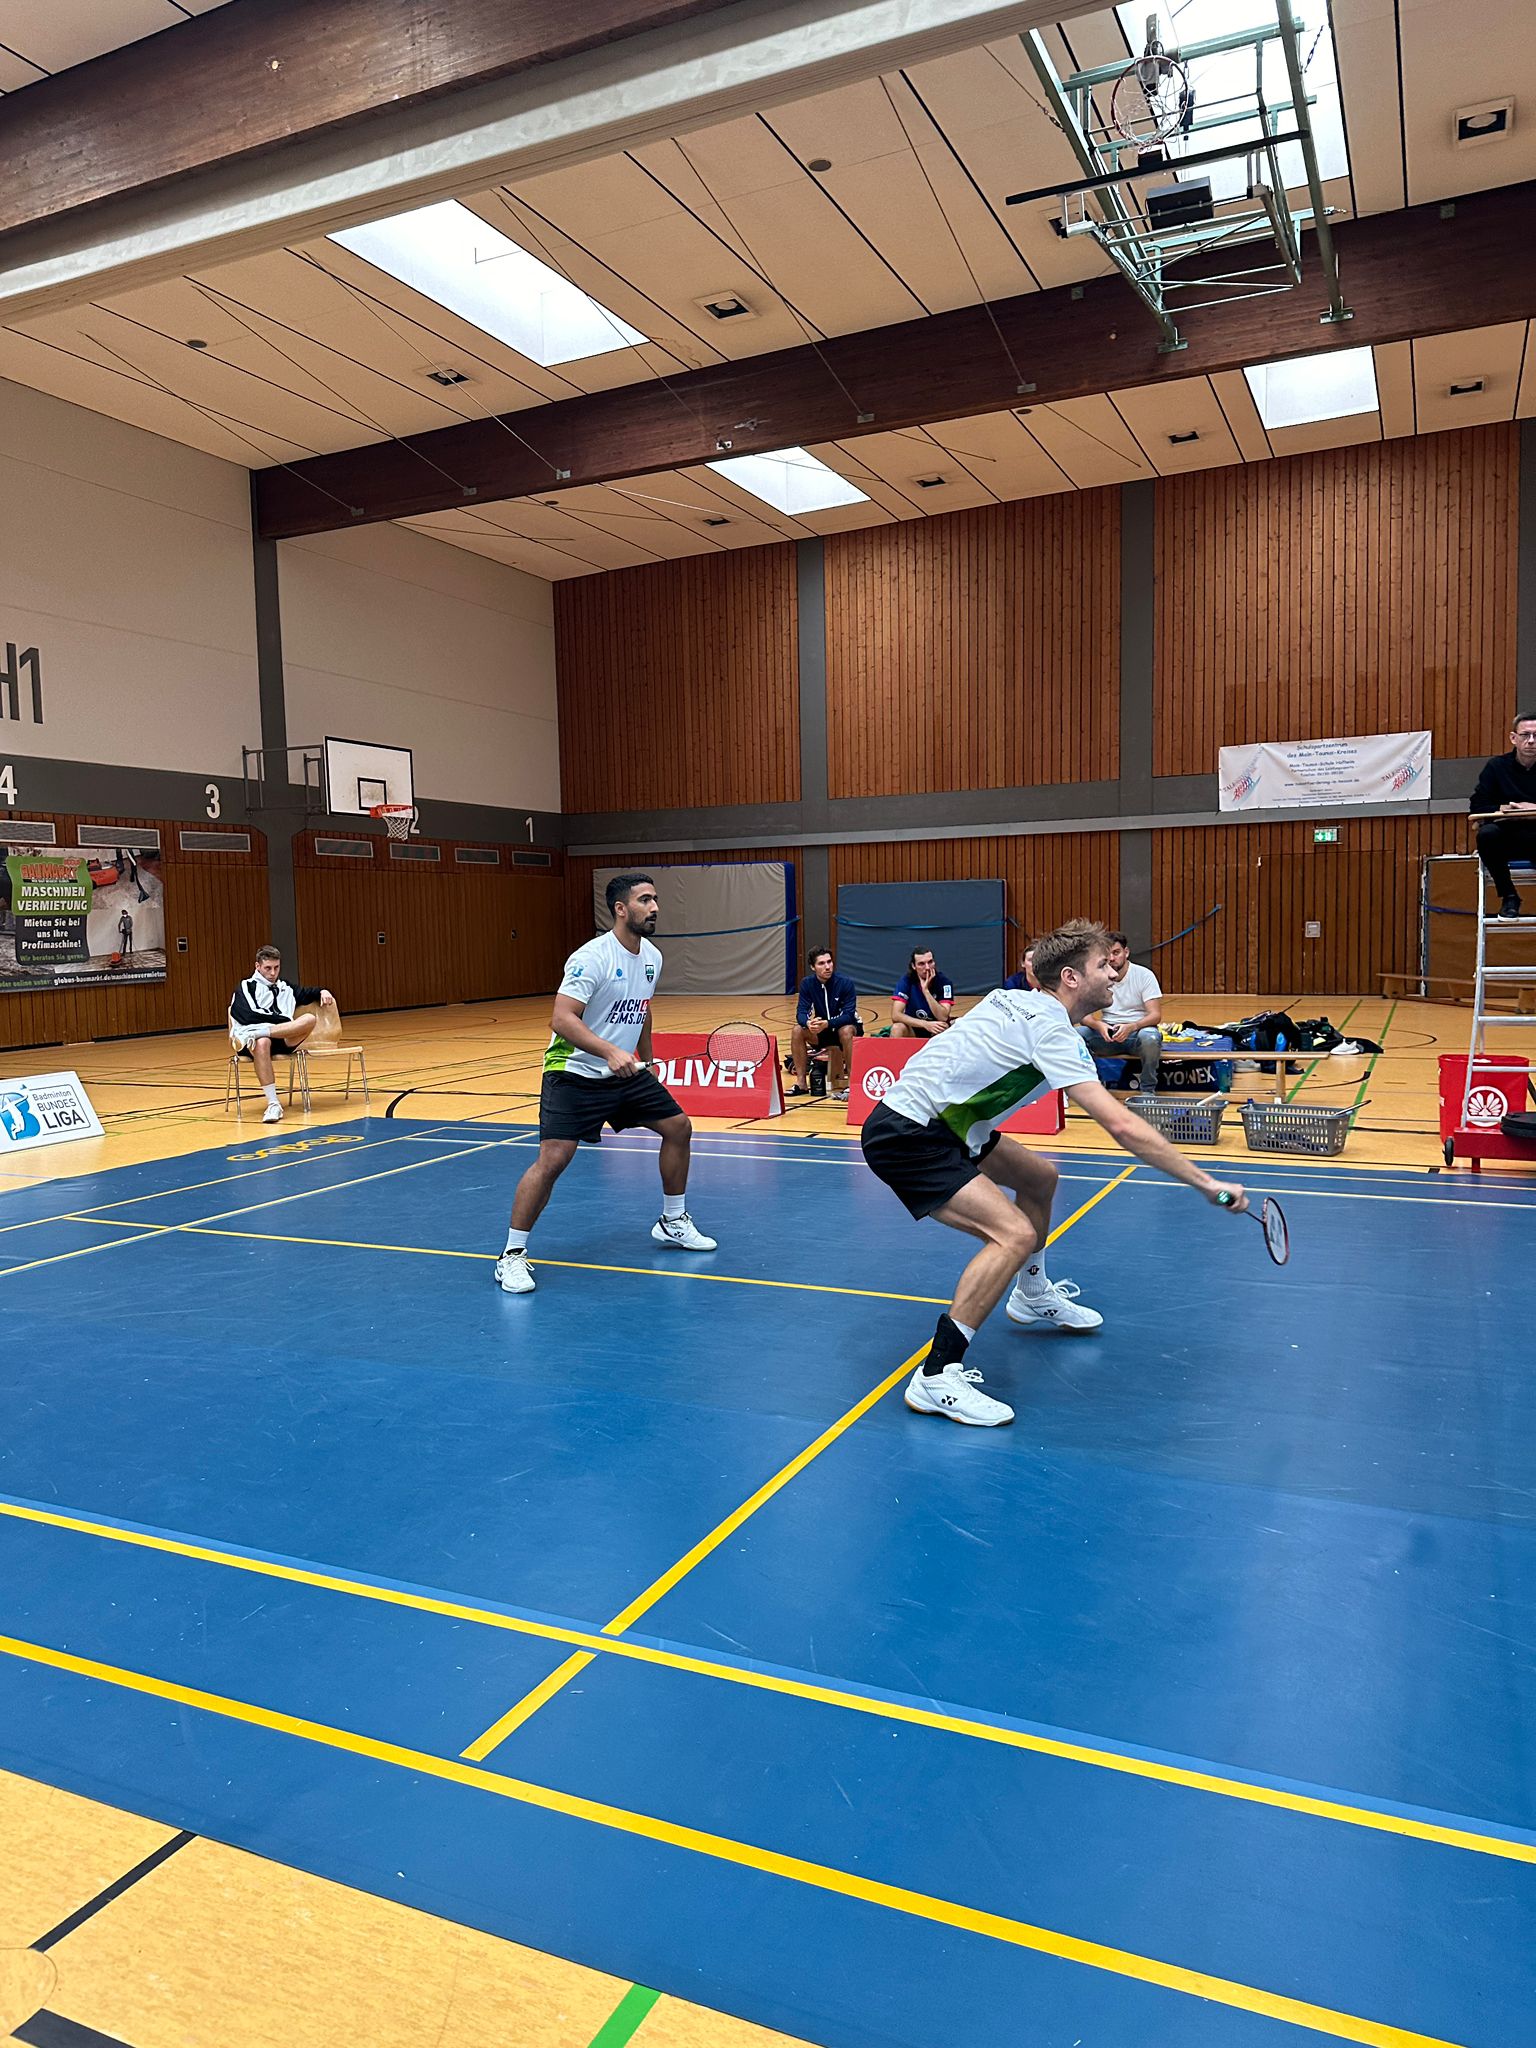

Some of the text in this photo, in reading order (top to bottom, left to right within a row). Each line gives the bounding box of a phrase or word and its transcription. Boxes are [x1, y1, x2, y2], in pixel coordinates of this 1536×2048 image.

[0, 765, 18, 805] 4
[205, 783, 221, 818] 3
[410, 806, 420, 834] 2
[525, 816, 534, 843] 1
[21, 886, 86, 897] MASCHINEN
[17, 900, 88, 911] VERMIETUNG
[24, 917, 80, 927] Mieten Sie bei
[53, 929, 69, 938] Ihre
[22, 940, 82, 950] Profimaschine!
[1163, 1066, 1216, 1085] YONEX
[32, 1090, 71, 1101] Badminton
[37, 1098, 77, 1112] BUNDES
[42, 1109, 86, 1129] LIGA
